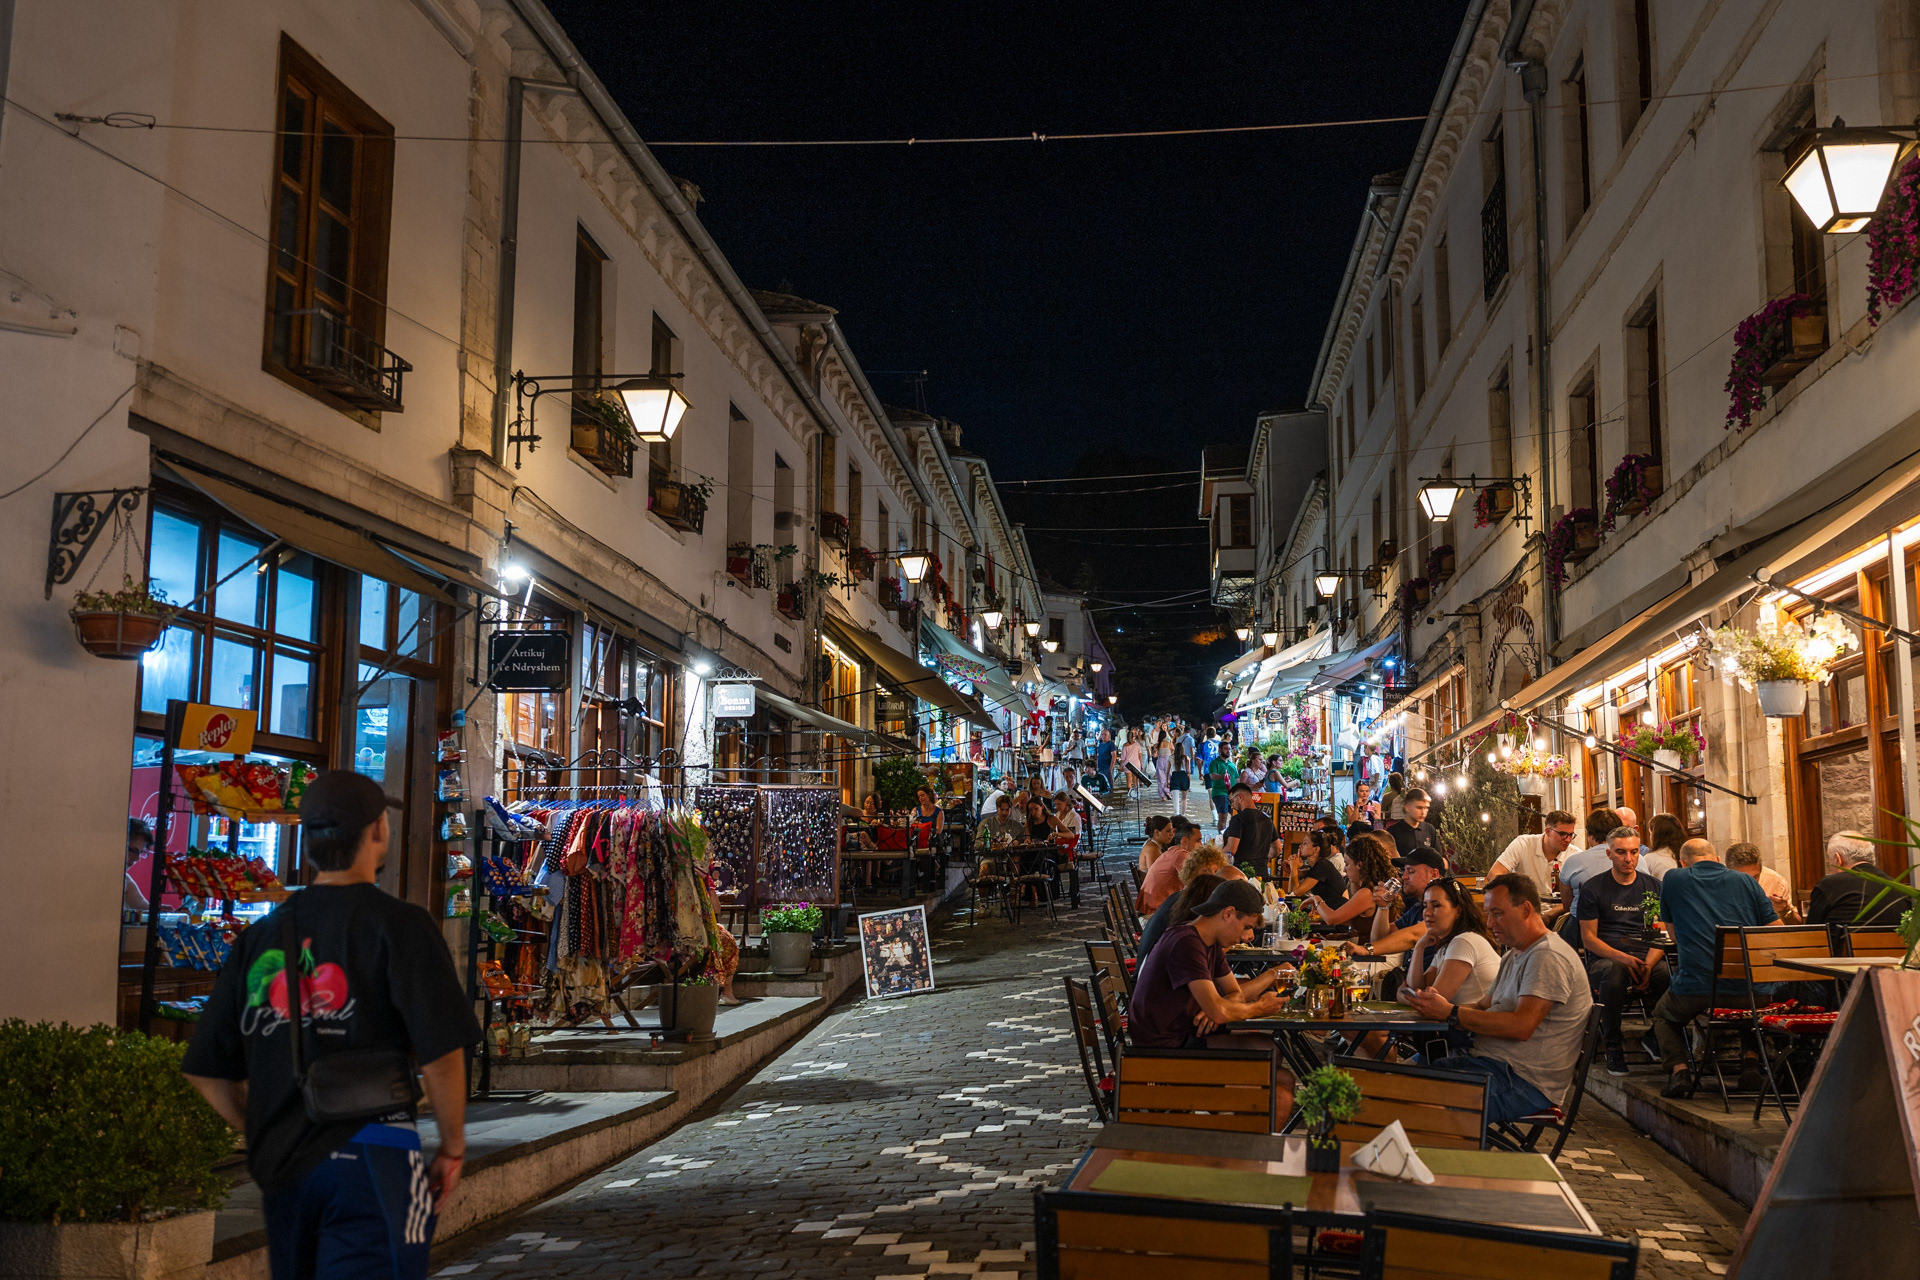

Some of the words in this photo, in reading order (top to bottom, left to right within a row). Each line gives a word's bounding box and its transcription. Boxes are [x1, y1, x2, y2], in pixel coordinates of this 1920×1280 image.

[512, 648, 545, 659] Artikuj
[512, 662, 561, 674] Ndryshem
[199, 717, 238, 746] Replay
